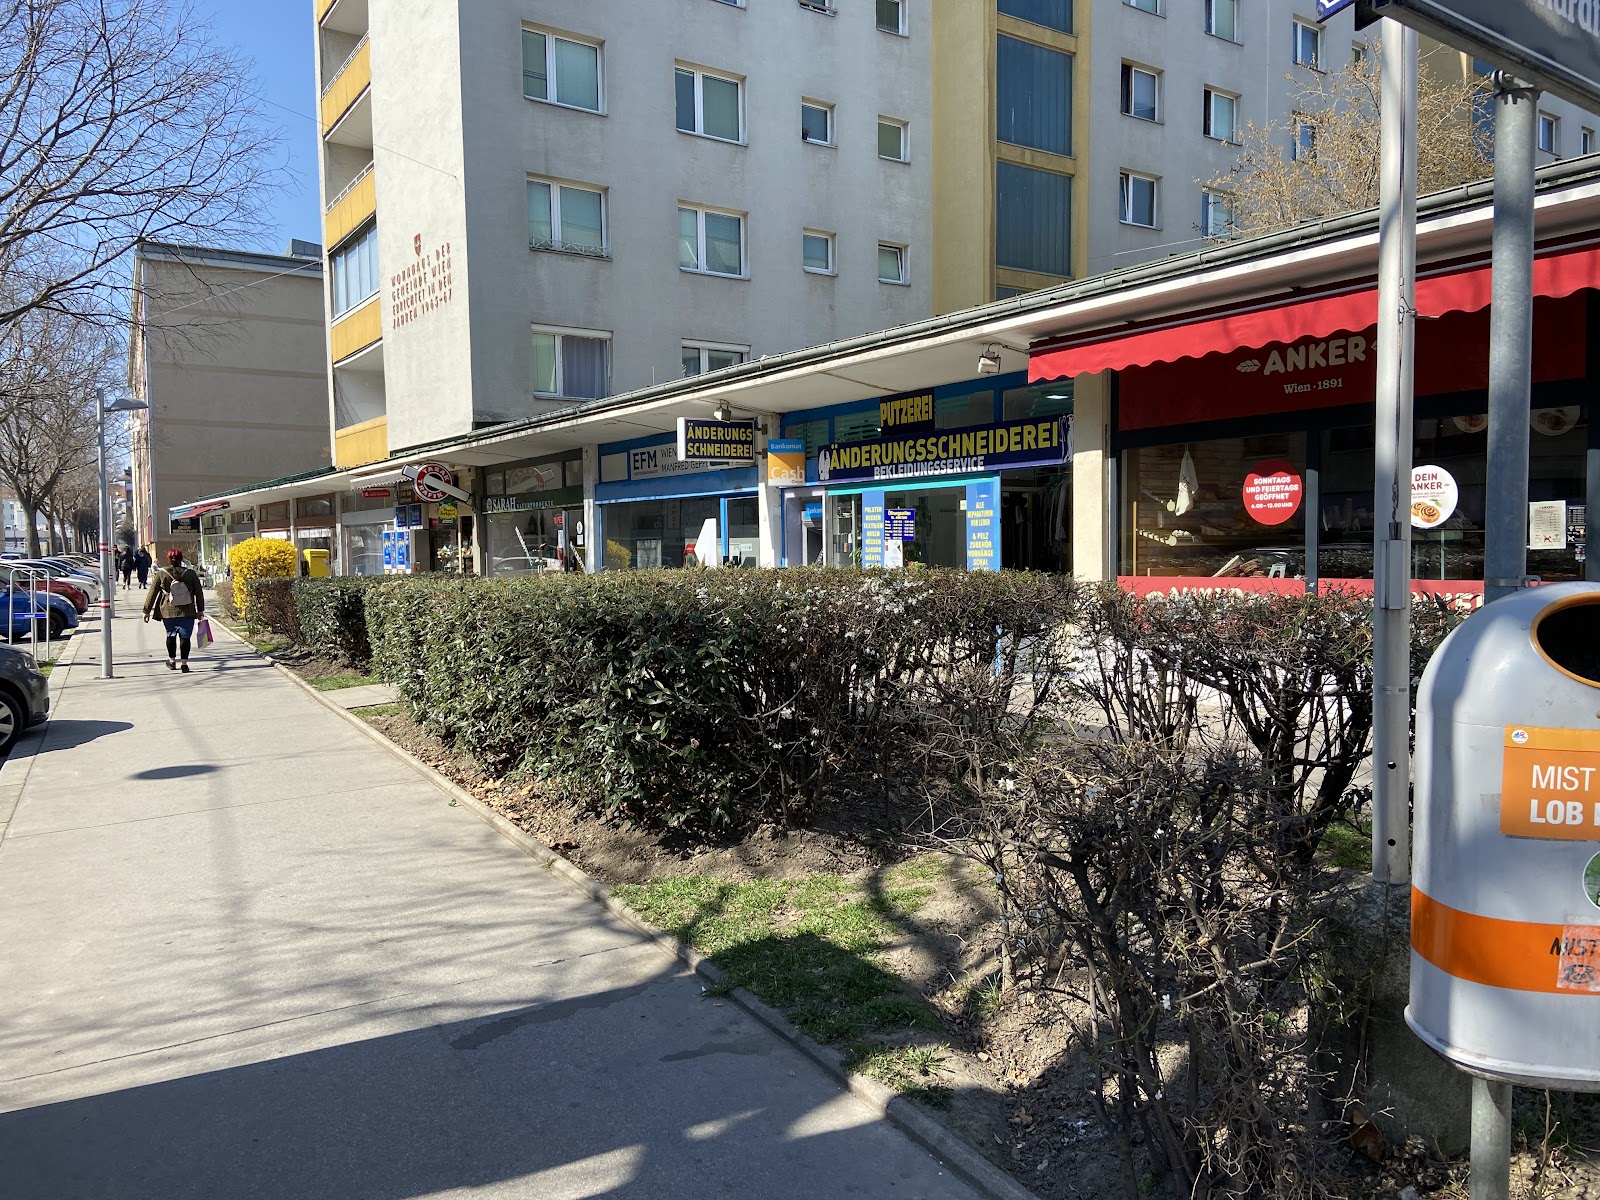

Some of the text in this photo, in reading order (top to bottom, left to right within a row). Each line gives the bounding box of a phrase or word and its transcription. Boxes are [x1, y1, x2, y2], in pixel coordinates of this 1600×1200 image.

[391, 242, 451, 288] WOHNHAUS DER
[392, 256, 452, 302] GEMEINDE WIEN
[392, 273, 452, 316] ERRICHTET IN DEN
[392, 306, 418, 330] JAHREN
[1263, 335, 1367, 376] ANKER
[1283, 378, 1343, 394] Wien 1891
[879, 394, 933, 427] PUTZEREI
[687, 424, 752, 440] ÄNDERUNGS
[687, 442, 753, 458] SCHNEIDEREI
[829, 421, 1058, 470] ÄNDERUNGSSCHNEIDEREI
[632, 450, 658, 470] EFM
[662, 461, 689, 472] MANFRED
[874, 456, 985, 480] BEKLEIDUNGSSERVICE
[422, 466, 450, 480] TABAK
[770, 466, 805, 480] Cash
[1254, 476, 1291, 484] SONNTAGS
[1414, 472, 1438, 482] DEIN
[418, 479, 444, 499] TRAFIK
[1254, 492, 1290, 500] GEÖFFNET
[1262, 484, 1299, 492] FEIERTAGS
[1411, 482, 1443, 490] ANKER
[492, 497, 516, 512] SARAH
[1532, 764, 1596, 792] MIST
[1530, 799, 1584, 825] LOB
[1550, 937, 1600, 957] MIST
